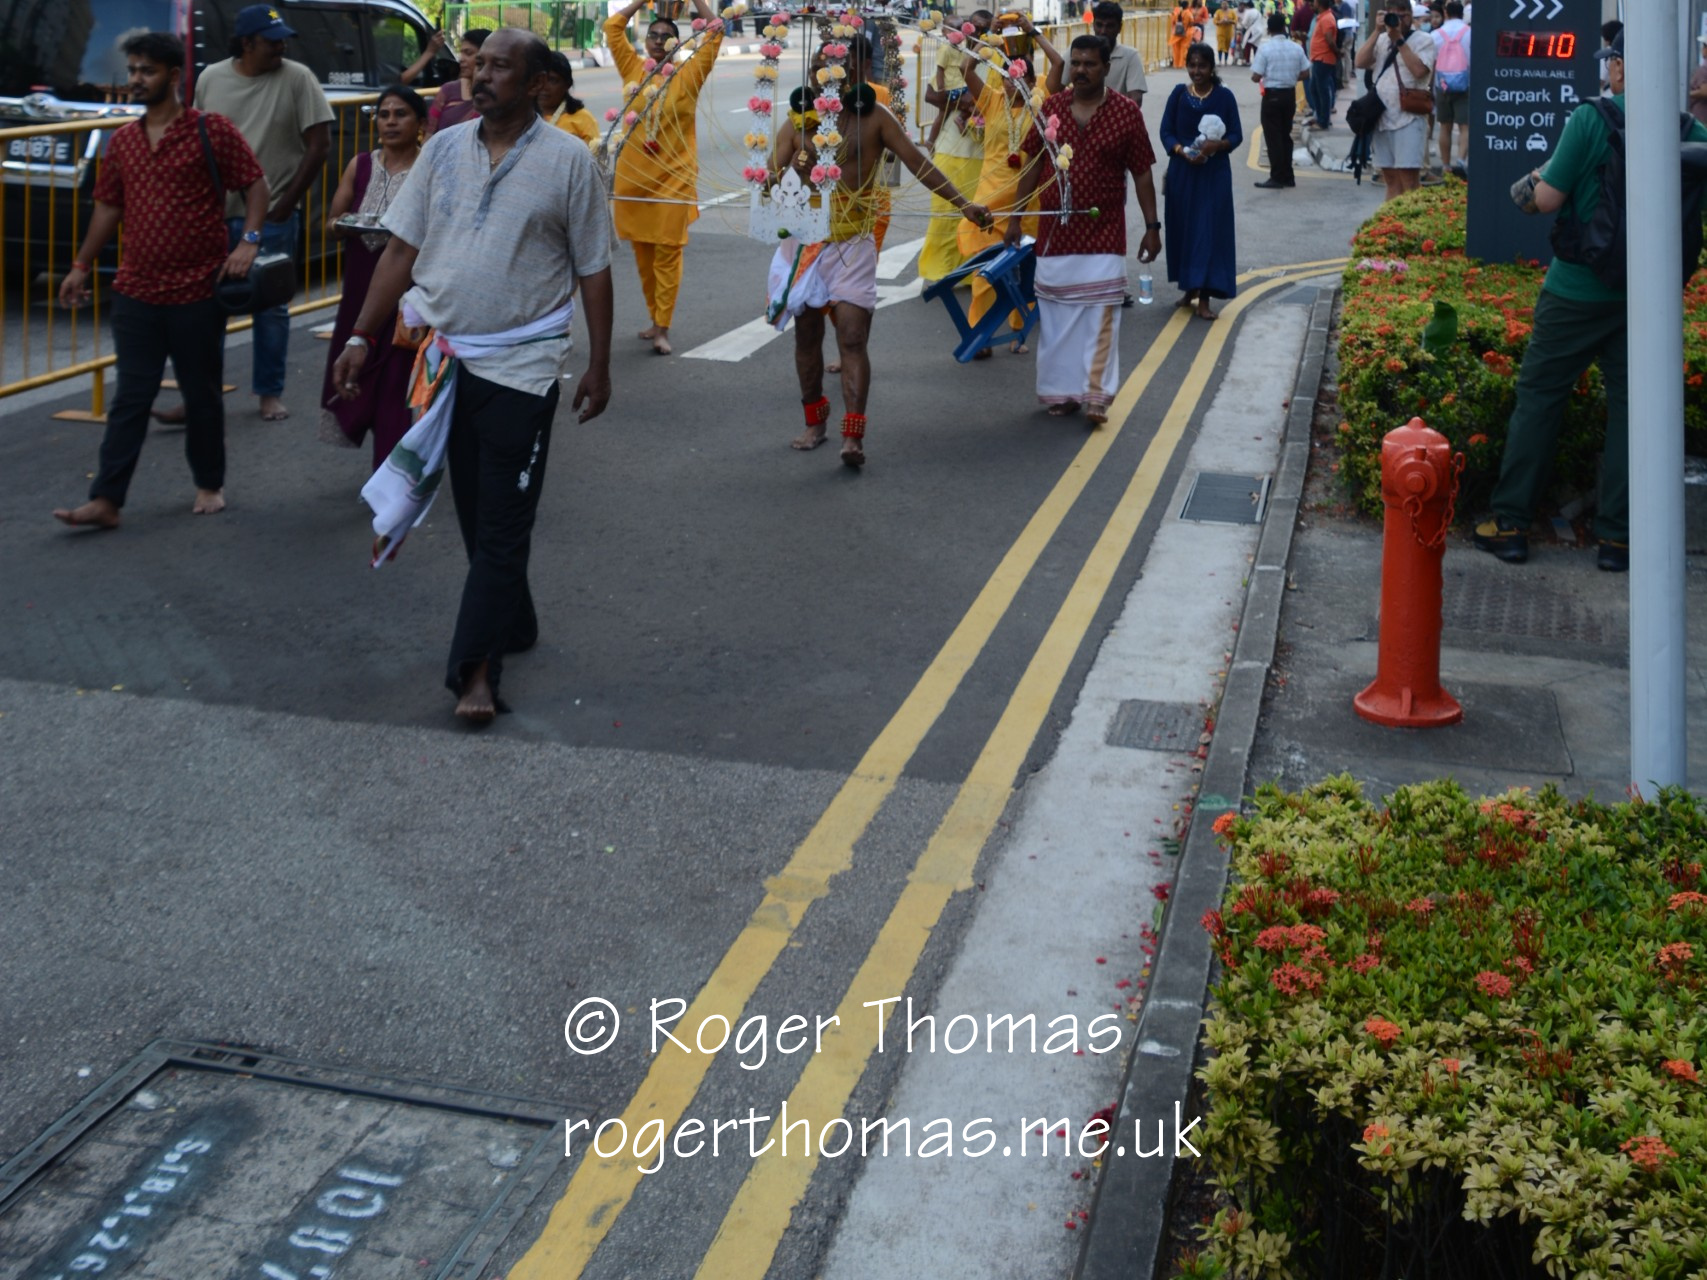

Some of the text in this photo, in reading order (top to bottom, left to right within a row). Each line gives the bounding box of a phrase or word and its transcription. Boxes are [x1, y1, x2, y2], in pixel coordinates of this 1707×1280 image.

[1528, 34, 1575, 58] 110
[1495, 69, 1575, 79] LOTS AVAILABLE
[1486, 86, 1551, 105] Carpark
[1486, 111, 1556, 130] Drop Off
[1485, 135, 1518, 151] Taxi
